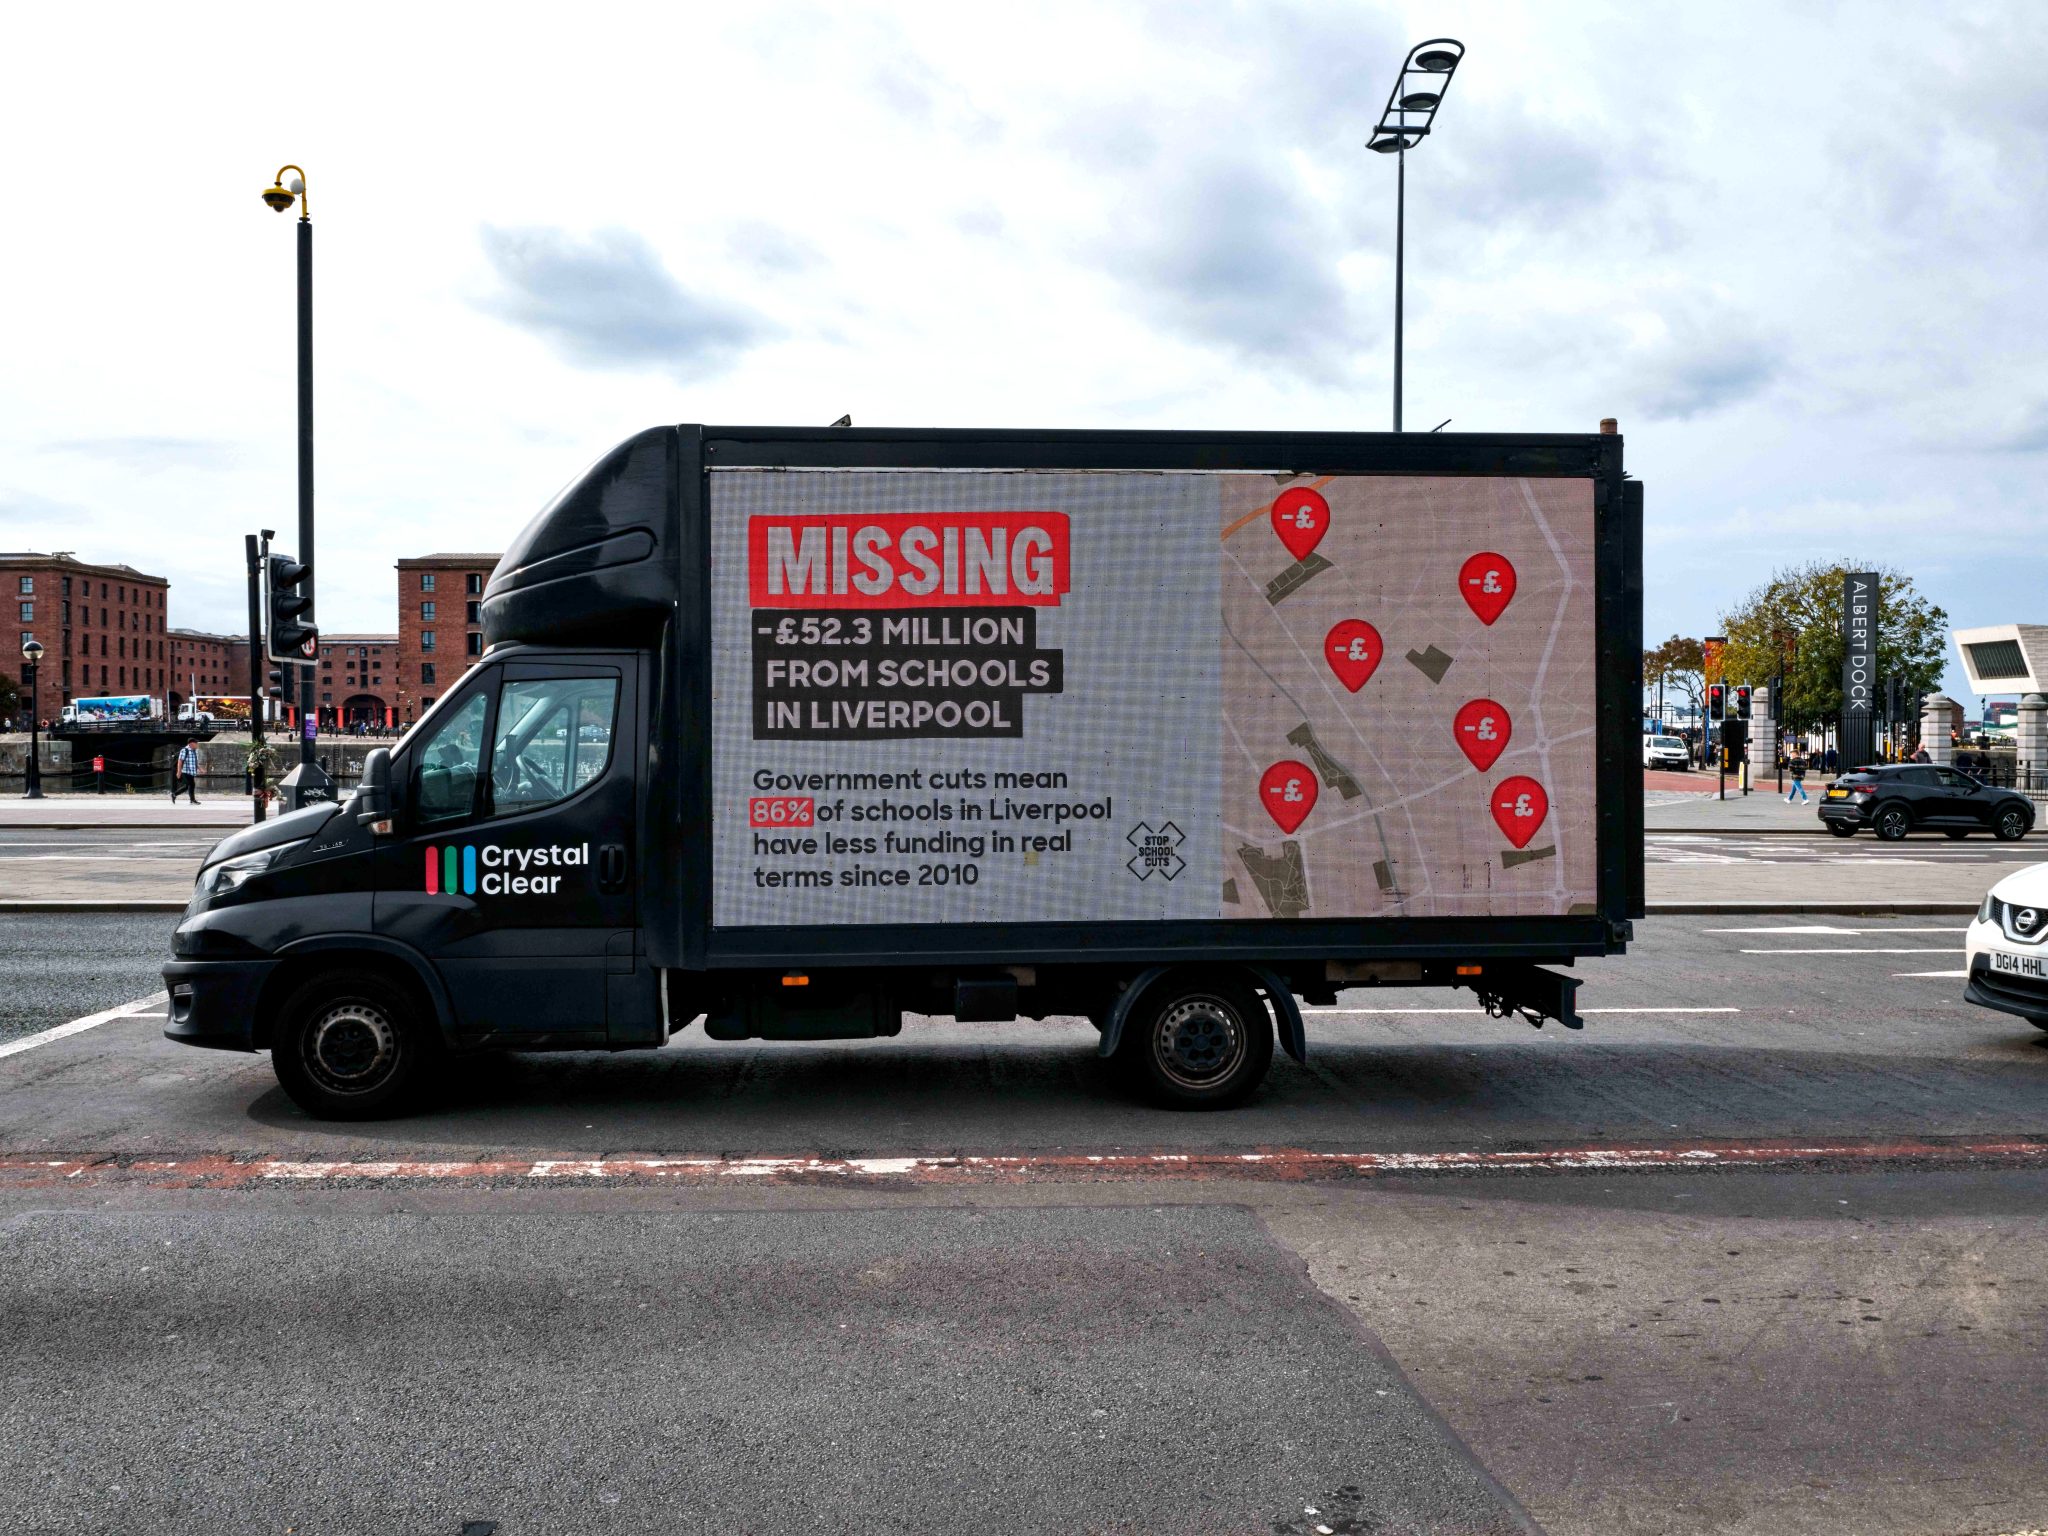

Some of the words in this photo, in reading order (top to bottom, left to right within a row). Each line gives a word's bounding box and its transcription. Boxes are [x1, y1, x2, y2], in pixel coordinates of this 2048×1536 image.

[1281, 505, 1315, 528] -£
[767, 526, 1054, 595] MISSING
[1469, 570, 1502, 593] -£
[1852, 580, 1868, 652] ALBERT
[757, 617, 873, 645] -£52.3
[882, 617, 1024, 645] MILLION
[1334, 637, 1368, 661] -£
[767, 660, 869, 687] FROM
[877, 659, 1050, 687] SCHOOLS
[1851, 656, 1867, 710] DOCK
[767, 701, 801, 729] IN
[811, 700, 1011, 729] LIVERPOOL
[1464, 716, 1497, 741] -£
[753, 768, 922, 790] Government
[928, 770, 987, 790] cuts
[994, 772, 1068, 789] mean
[1269, 779, 1303, 802] -£
[753, 800, 811, 823] 86%
[817, 798, 844, 822] of
[850, 798, 953, 822] schools
[960, 798, 982, 821] in
[989, 797, 1112, 824] Liverpool
[1501, 793, 1534, 817] -£
[753, 833, 818, 855] have
[825, 832, 877, 854] less
[884, 831, 986, 858] funding
[992, 830, 1015, 853] in
[1021, 829, 1071, 852] real
[1138, 846, 1176, 857] SCHOOL
[1144, 835, 1169, 846] STOP
[481, 842, 589, 871] Crystal
[1144, 857, 1170, 867] CUTS
[481, 872, 562, 895] Clear
[754, 865, 833, 887] terms
[840, 864, 911, 887] since
[918, 863, 979, 886] 2010
[1995, 952, 2019, 973] DG14
[2022, 958, 2047, 977] HHL
